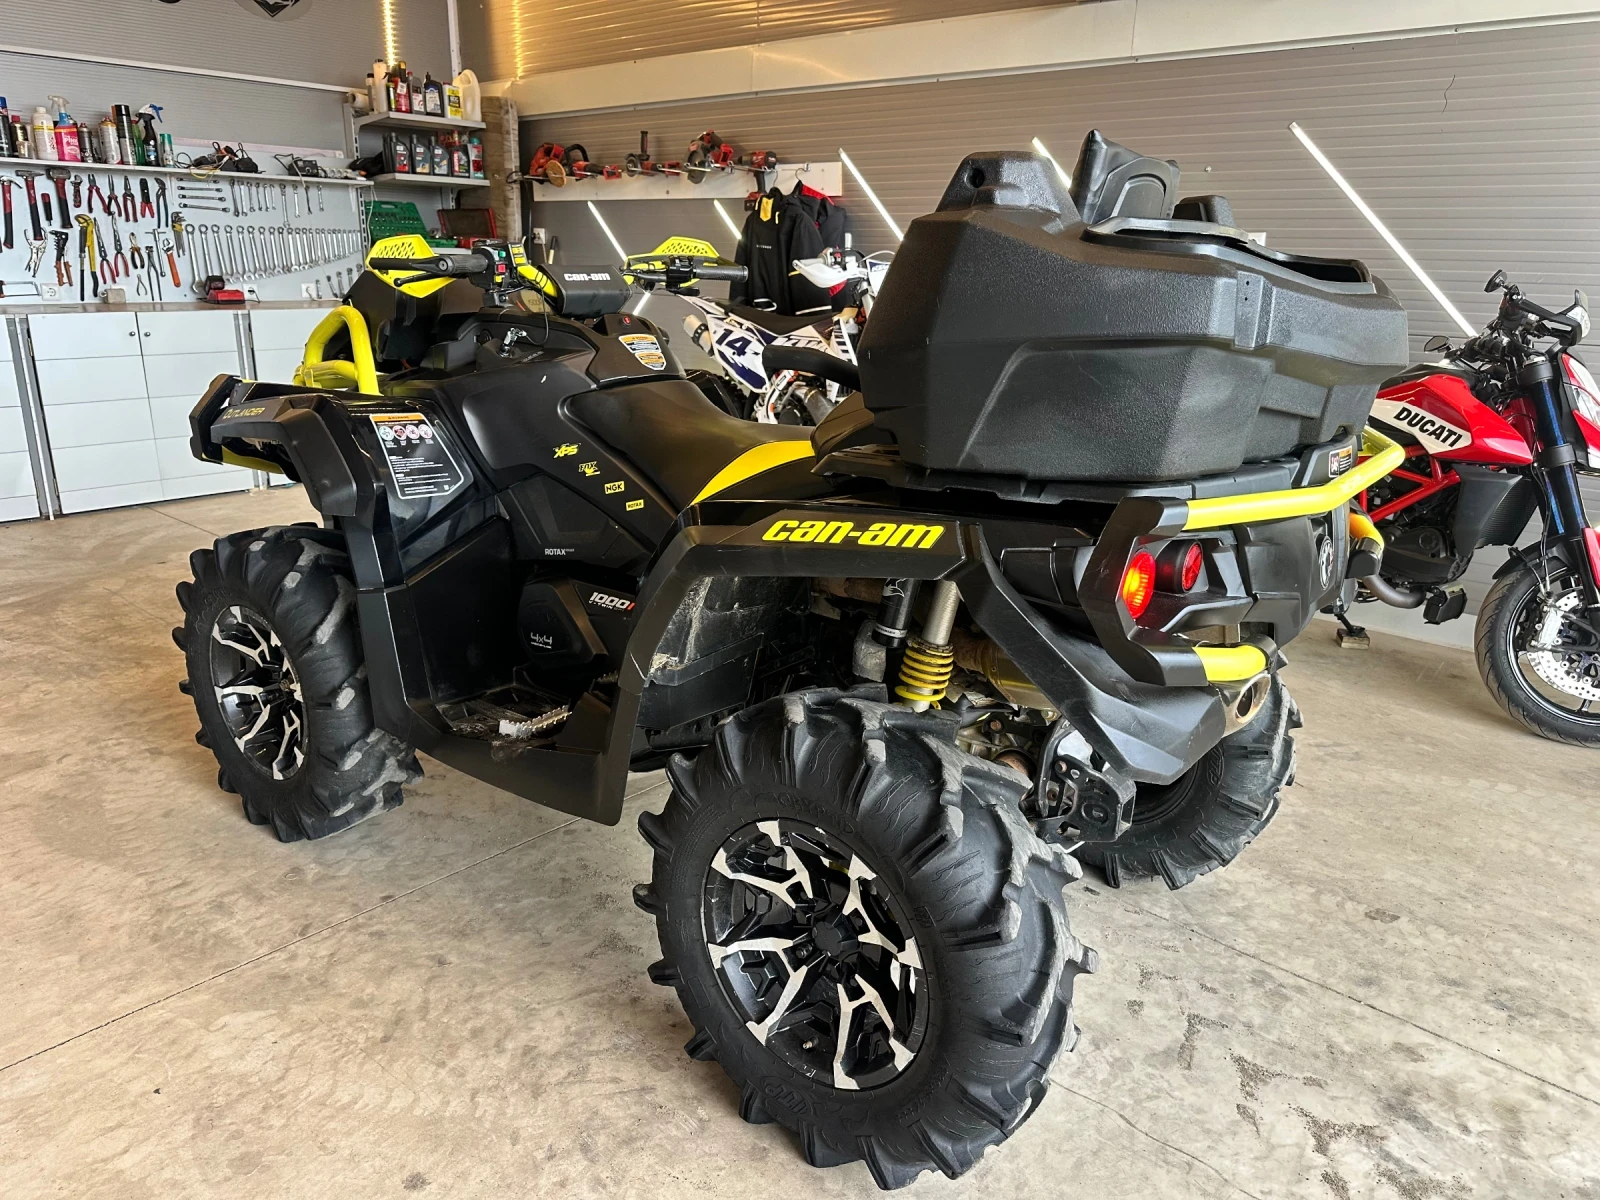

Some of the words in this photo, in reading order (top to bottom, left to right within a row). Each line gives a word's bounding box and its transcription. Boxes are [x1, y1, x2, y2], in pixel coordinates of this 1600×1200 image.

[563, 272, 611, 281] can-am
[715, 328, 752, 357] 14
[1393, 406, 1463, 447] DUCATI
[553, 443, 580, 458] XPS
[605, 483, 623, 492] NGK
[762, 520, 946, 549] can-am
[544, 548, 566, 556] ROTAX
[530, 632, 553, 645] 4x4
[765, 1082, 809, 1115] ITP
